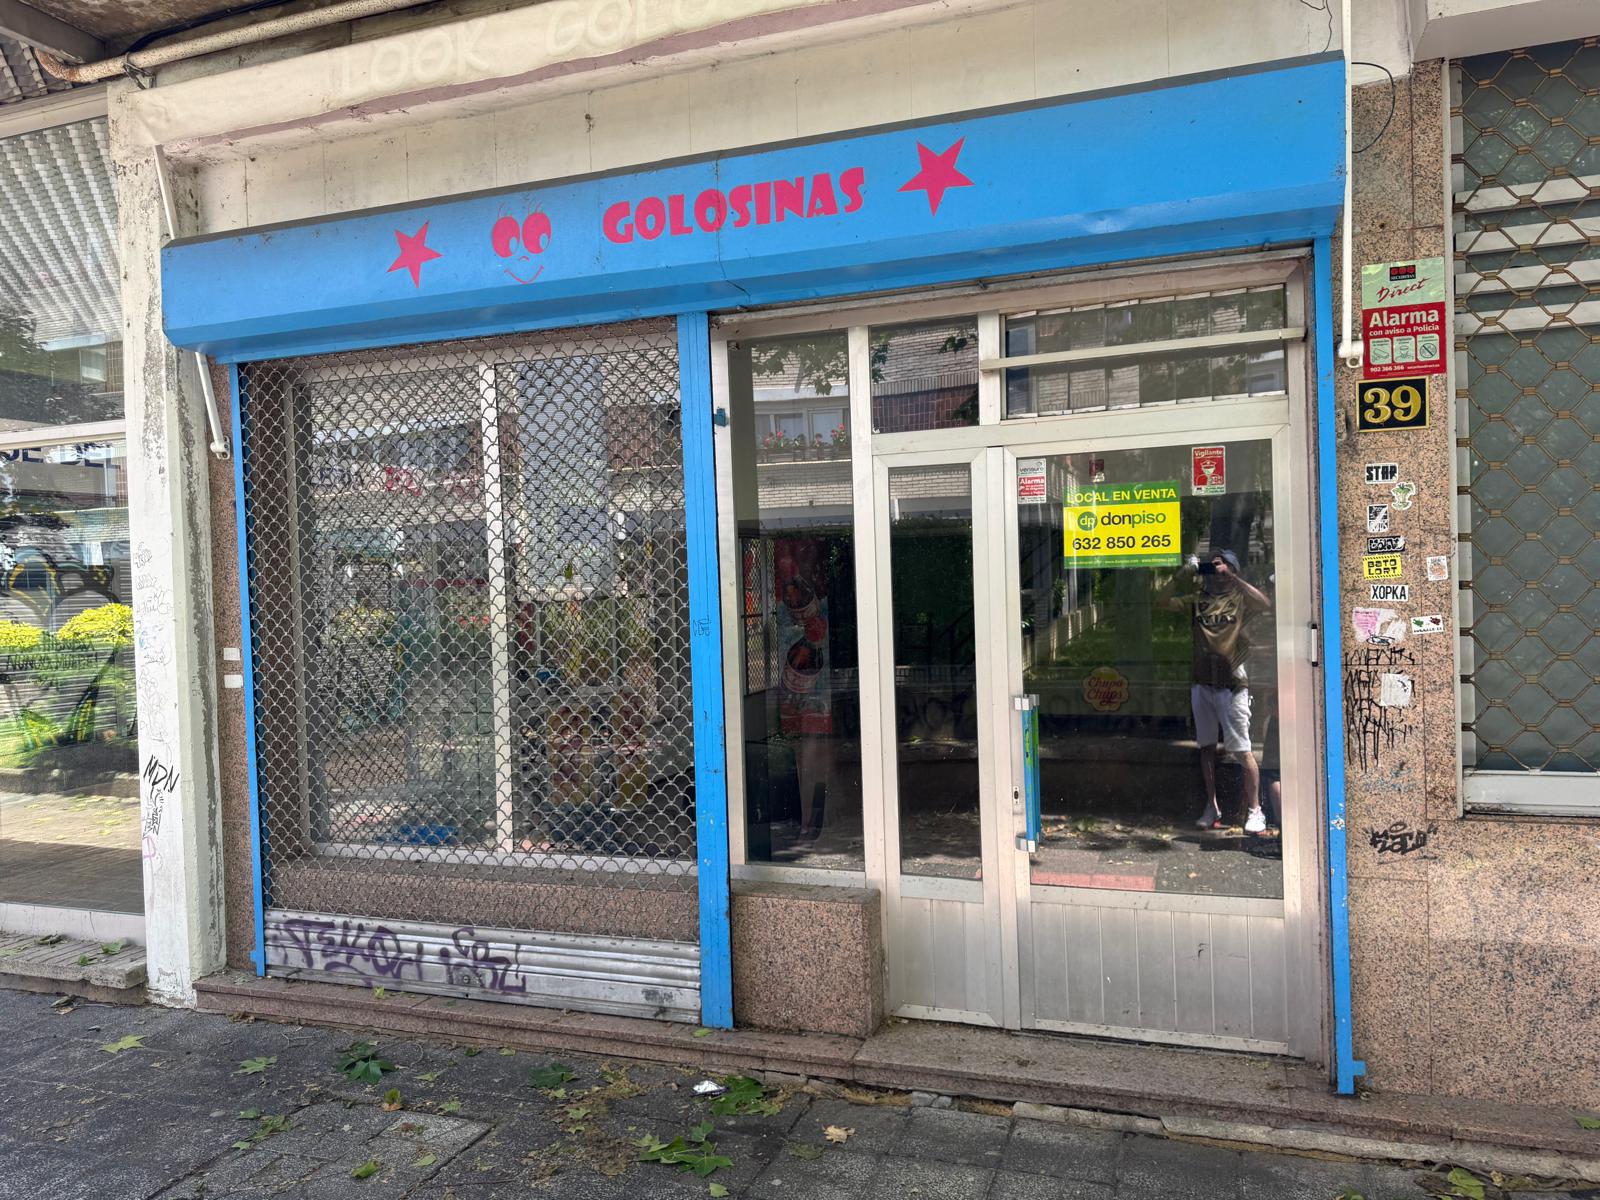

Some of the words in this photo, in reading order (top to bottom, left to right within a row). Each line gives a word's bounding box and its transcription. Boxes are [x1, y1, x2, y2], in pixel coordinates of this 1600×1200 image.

[602, 166, 864, 244] GOLOSINAS
[1376, 277, 1431, 303] Direct
[1369, 309, 1439, 328] Alarma
[1384, 326, 1405, 335] aviso
[1364, 385, 1421, 424] 39
[1066, 491, 1109, 504] LOCAL
[1112, 490, 1130, 501] EN
[1133, 488, 1177, 500] VENTA
[1100, 510, 1167, 529] donpiso
[1072, 537, 1101, 550] 632
[1106, 536, 1136, 549] 850
[1141, 534, 1171, 548] 265
[1371, 585, 1407, 600] XOPKA
[1088, 676, 1124, 689] Chupa
[143, 754, 180, 793] MDN
